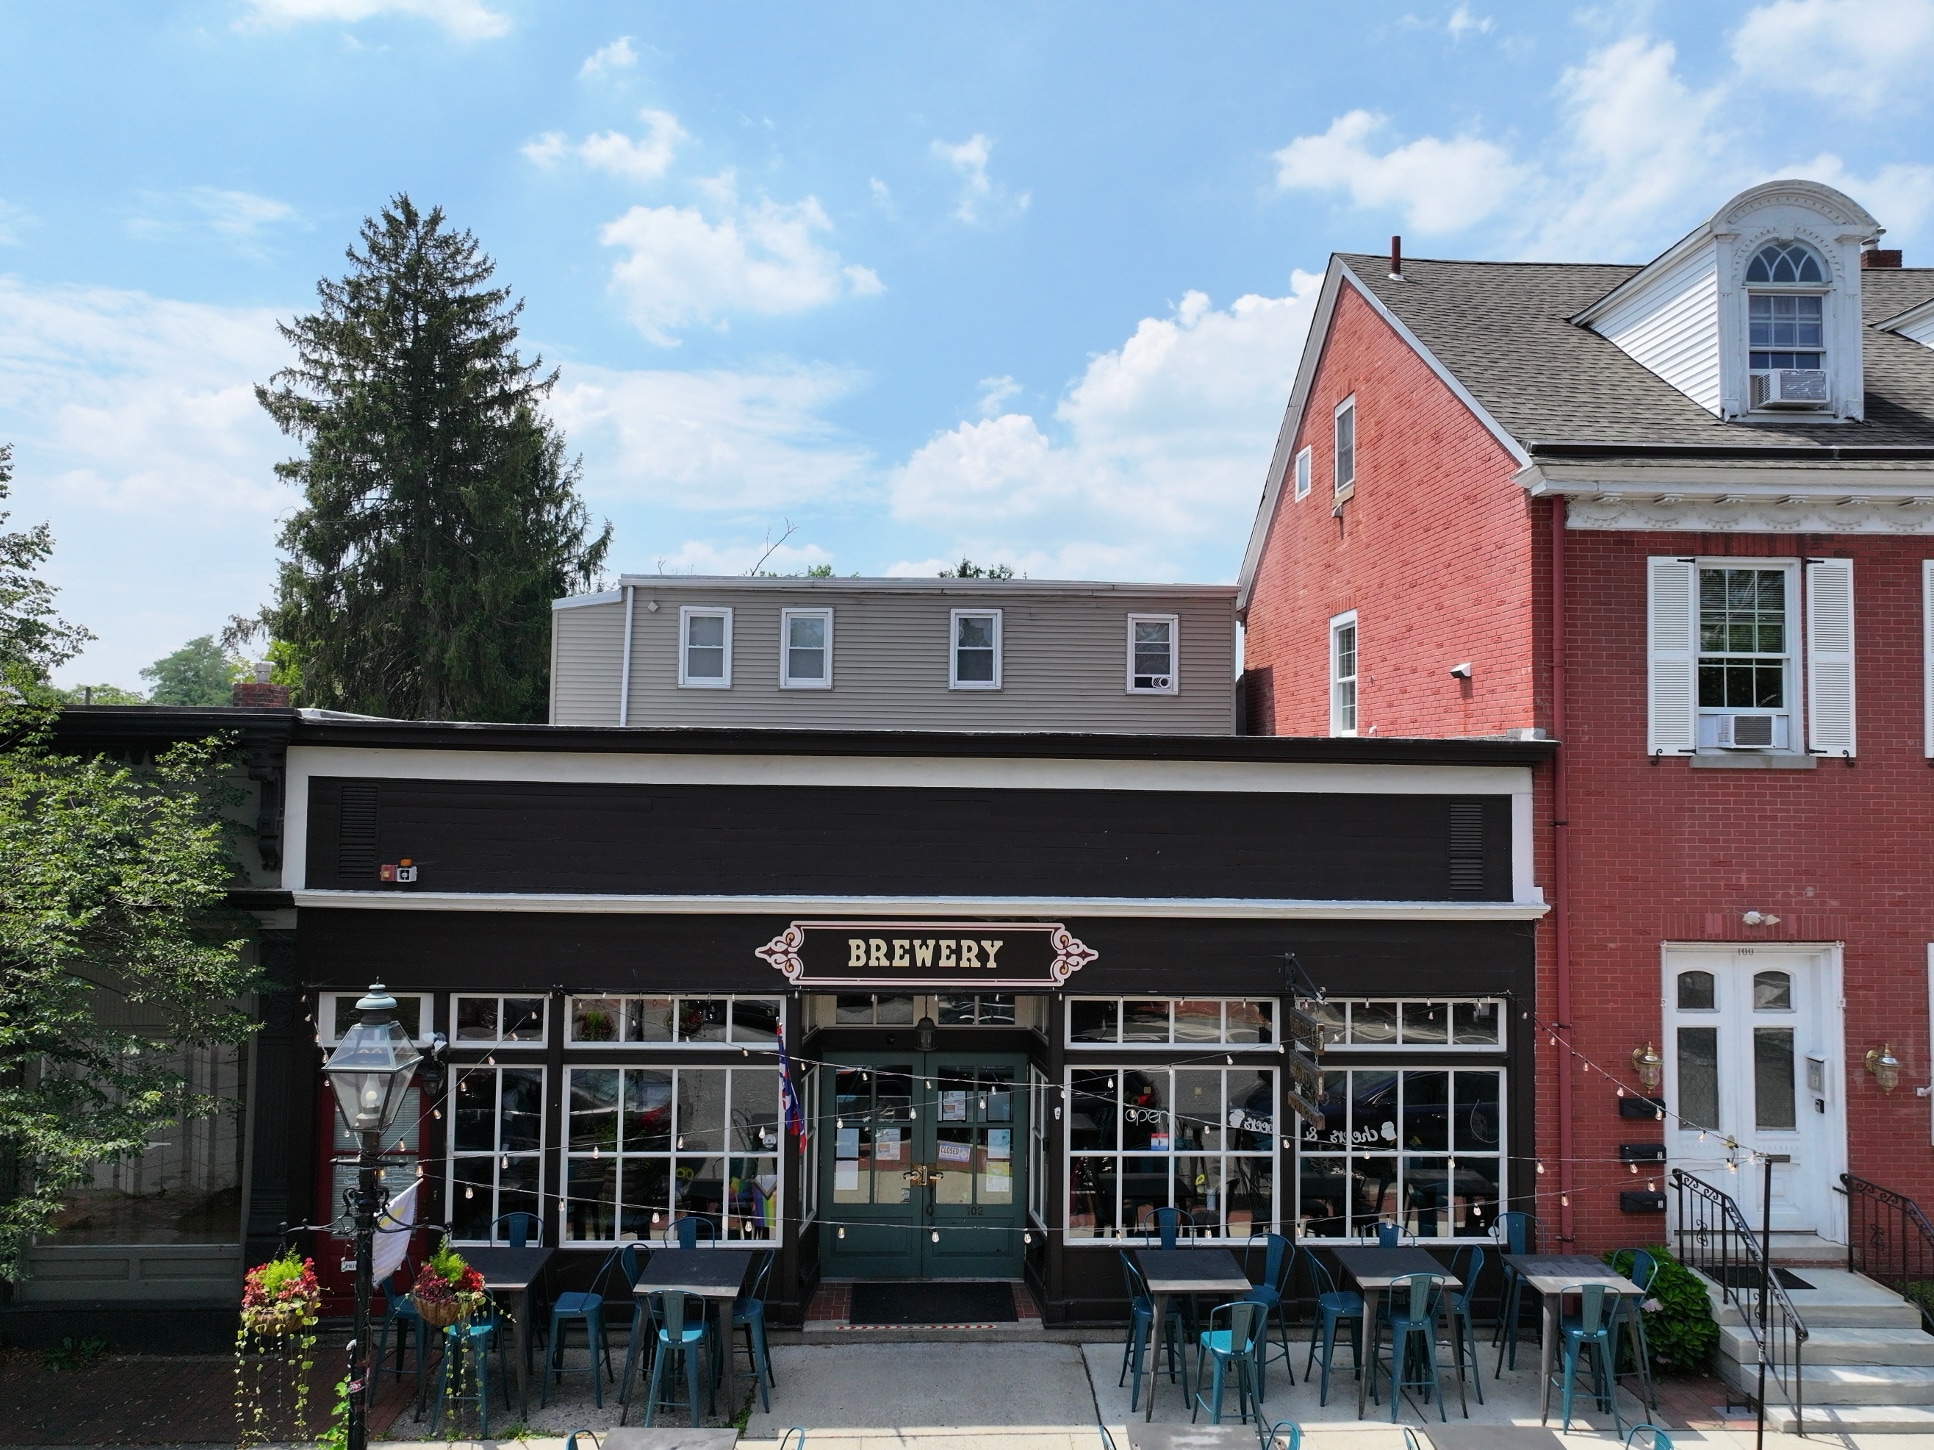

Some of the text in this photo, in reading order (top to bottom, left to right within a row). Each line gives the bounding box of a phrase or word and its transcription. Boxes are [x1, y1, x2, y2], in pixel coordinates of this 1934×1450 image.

[847, 938, 1004, 968] BREWERY
[1738, 947, 1754, 956] 100
[1125, 1109, 1170, 1127] open
[940, 1145, 960, 1156] CLOSED
[967, 1206, 985, 1216] 102
